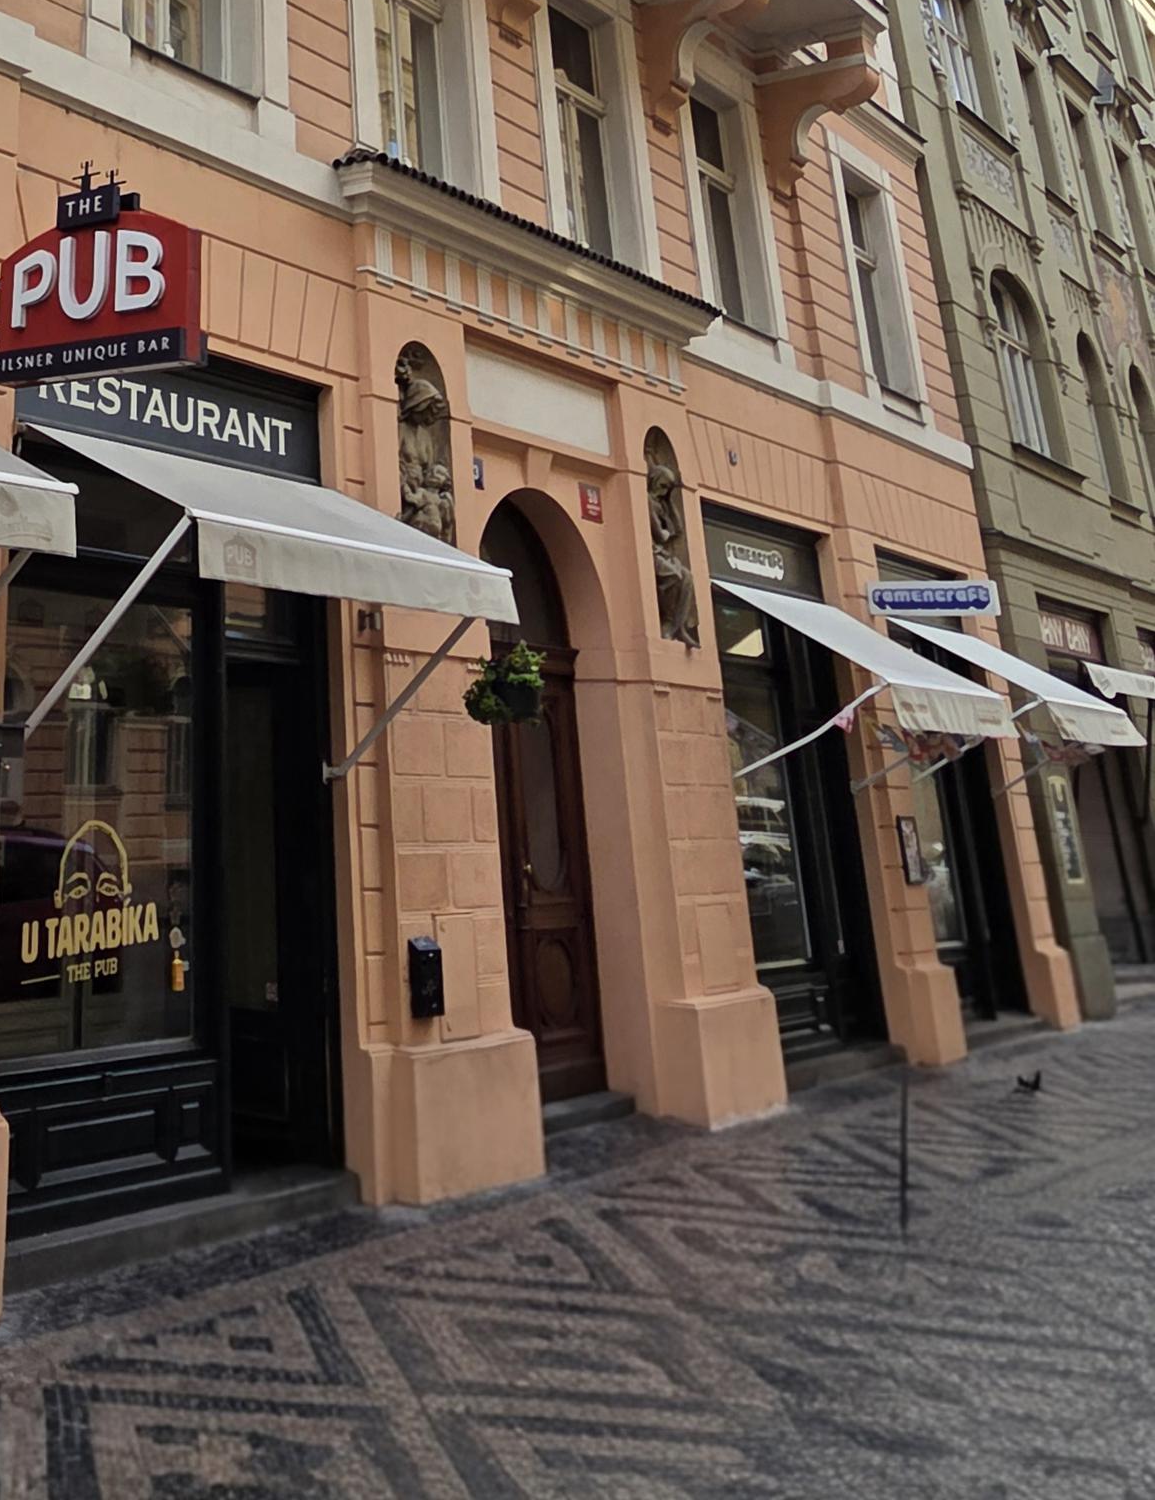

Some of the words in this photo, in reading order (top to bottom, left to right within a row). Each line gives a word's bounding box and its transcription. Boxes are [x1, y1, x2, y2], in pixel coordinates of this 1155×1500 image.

[65, 195, 104, 219] THE
[10, 229, 166, 329] PUB
[62, 342, 128, 365] UNIQUE
[137, 336, 171, 353] BAR
[226, 544, 253, 567] PUB
[21, 920, 40, 964] U
[45, 897, 159, 960] TARABÍKA
[67, 962, 91, 984] THE
[94, 957, 119, 978] PUB
